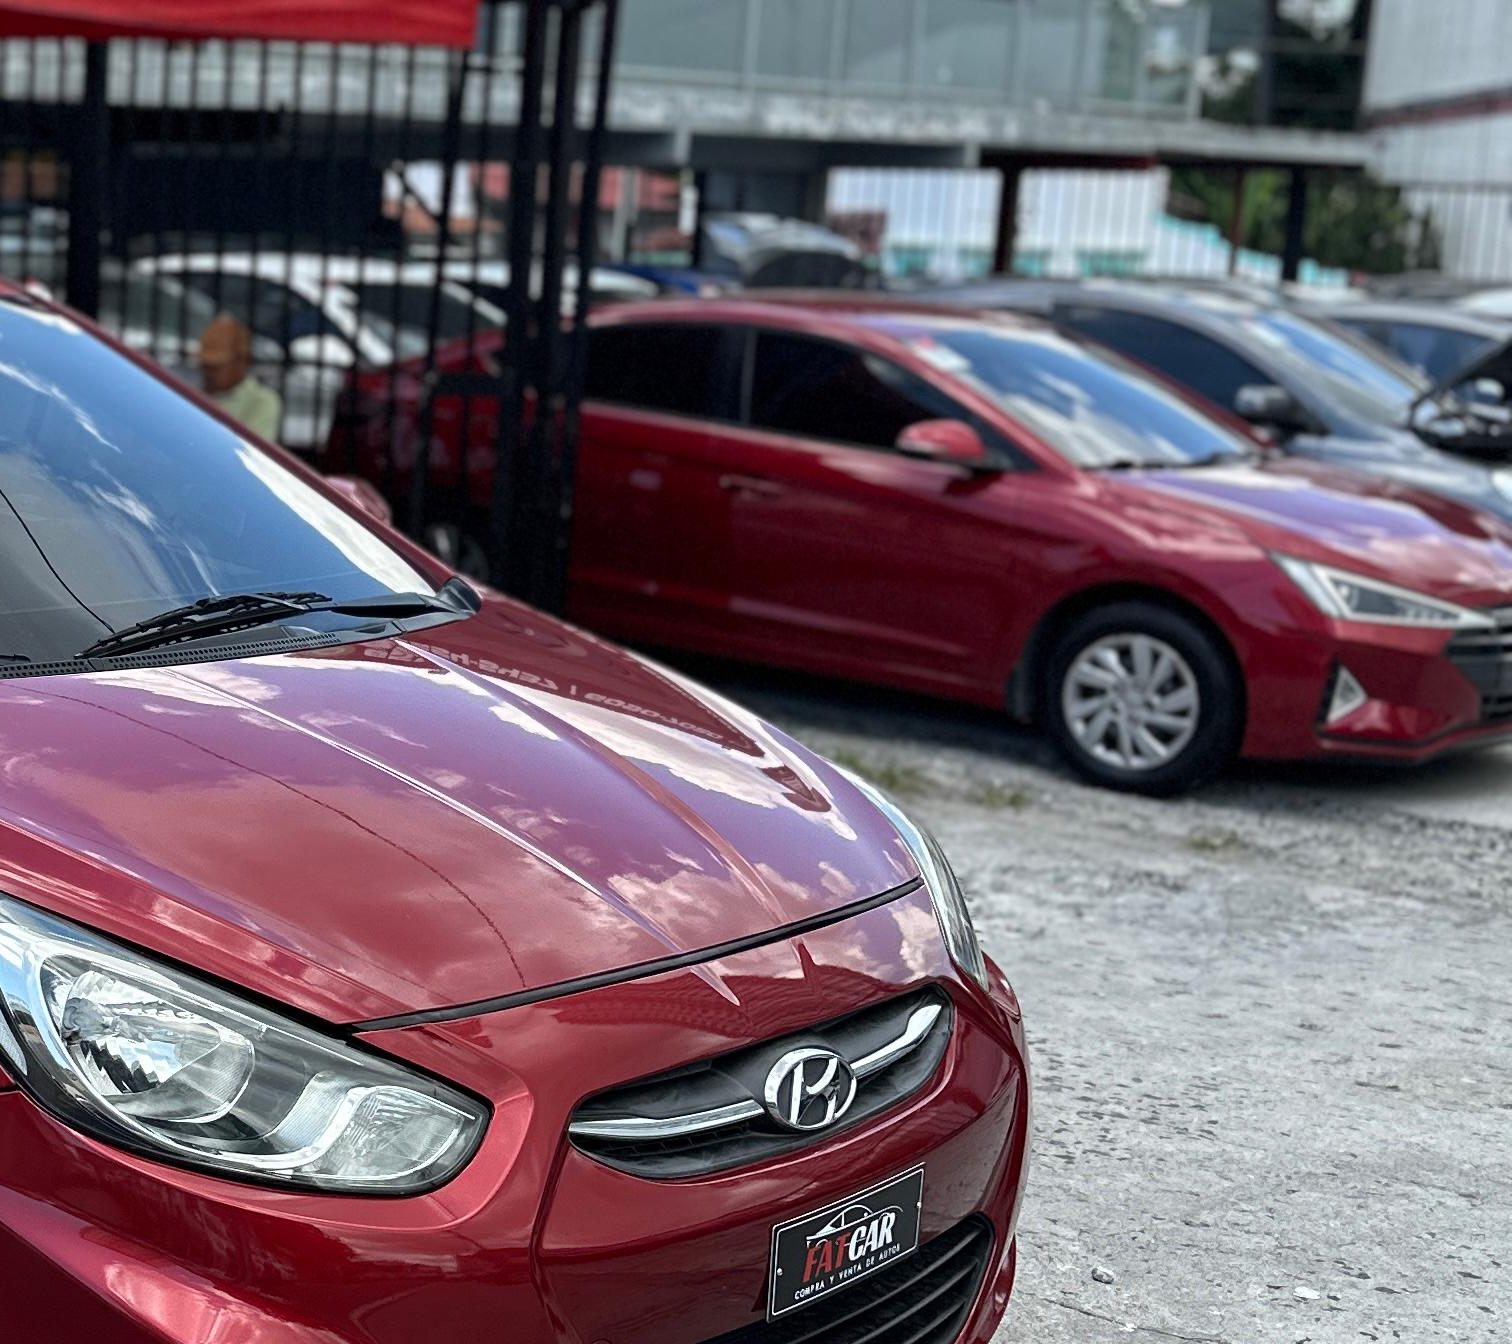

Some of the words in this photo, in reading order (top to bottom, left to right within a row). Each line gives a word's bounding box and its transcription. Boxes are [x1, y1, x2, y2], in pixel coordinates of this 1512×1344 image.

[794, 1280, 825, 1300] COMPRA
[829, 1273, 835, 1285] Y
[838, 1262, 862, 1281] VENTA
[865, 1256, 875, 1267] DE
[878, 1243, 901, 1260] AUTOS
